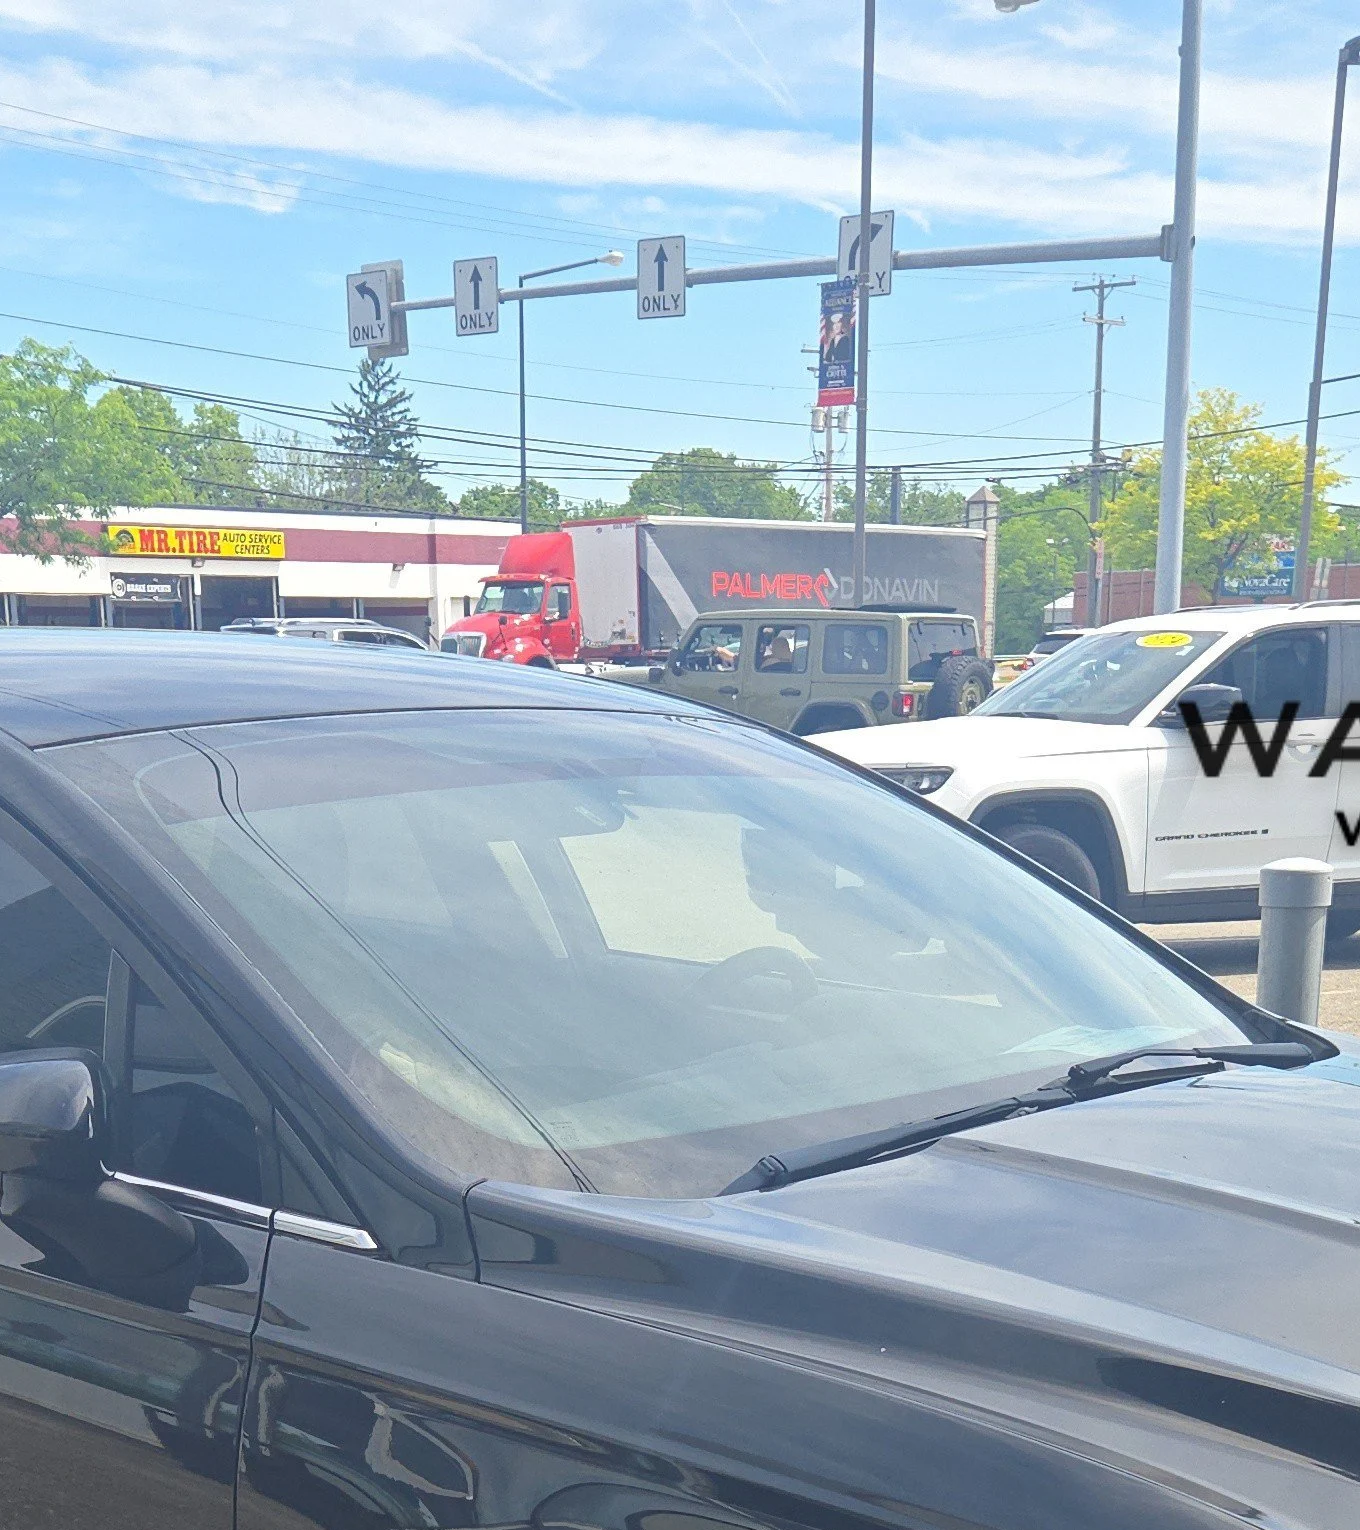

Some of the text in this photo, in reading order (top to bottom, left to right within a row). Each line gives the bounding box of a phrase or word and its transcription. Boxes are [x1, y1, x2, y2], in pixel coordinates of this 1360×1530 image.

[642, 293, 681, 313] ONLY
[460, 311, 495, 331] ONLY
[352, 323, 386, 342] ONLY
[139, 529, 221, 554] MR.TIRE
[222, 533, 282, 545] AUTO SERVICE
[234, 544, 270, 555] CENTERS
